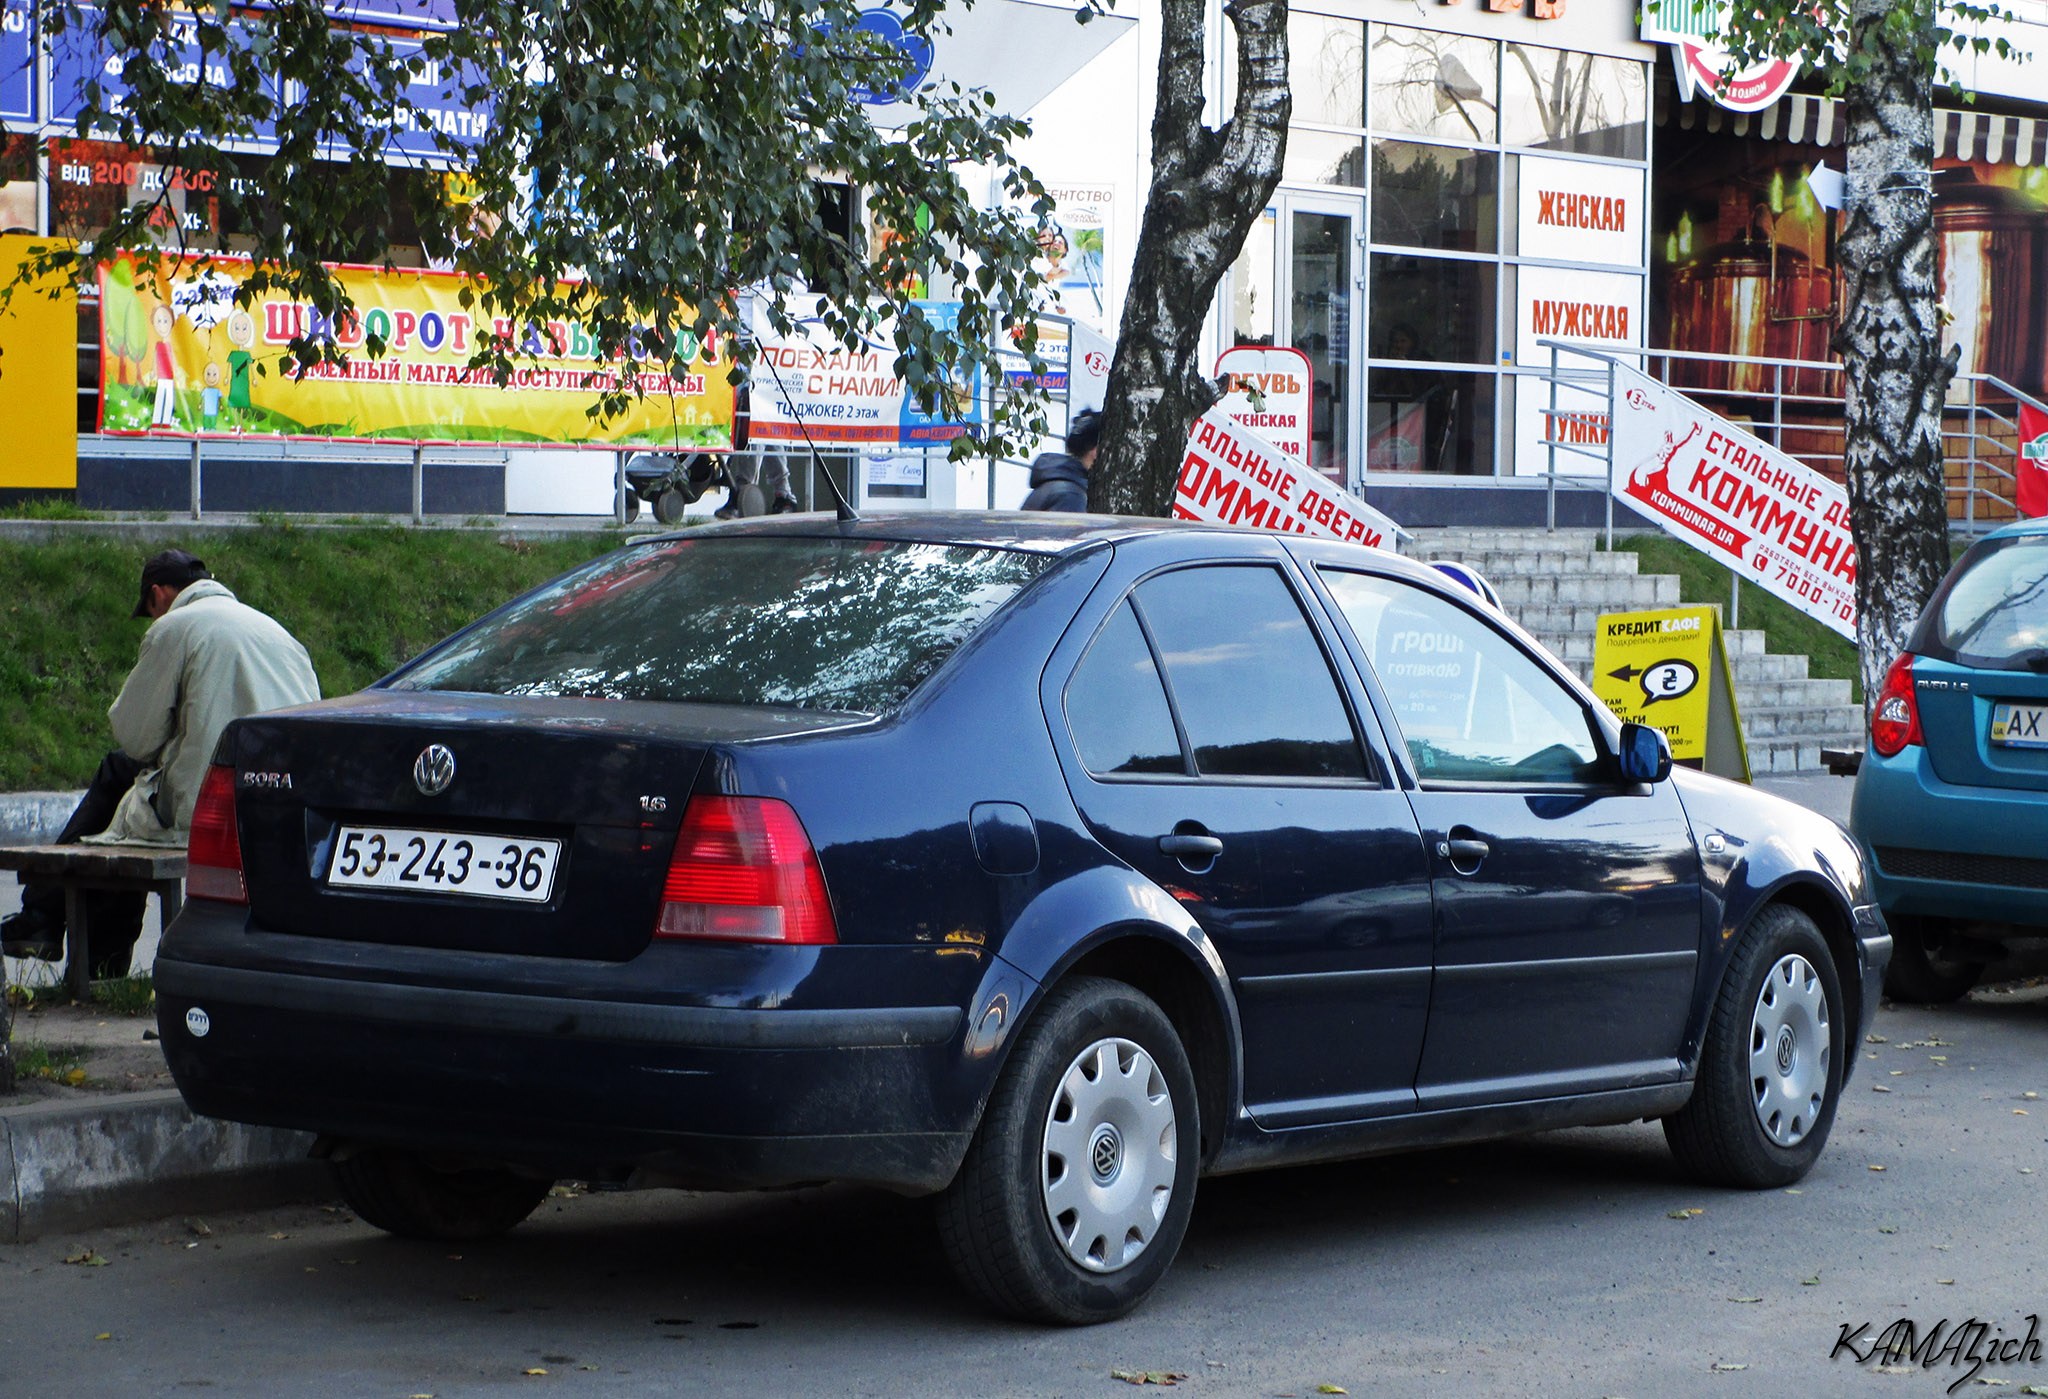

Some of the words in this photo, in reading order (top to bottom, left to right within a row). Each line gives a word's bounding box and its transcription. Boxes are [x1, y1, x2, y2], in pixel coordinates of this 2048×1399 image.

[61, 159, 91, 185] від
[94, 162, 136, 185] 200
[1537, 190, 1625, 232] ЖЕНСКАЯ
[265, 302, 470, 352] ШИВОРОТ
[1533, 300, 1628, 340] МУЖСКАЯ
[759, 347, 878, 372] ПОЕХАЛИ
[1039, 343, 1046, 353] 2
[1093, 358, 1102, 371] 3
[808, 375, 823, 394] С
[828, 376, 900, 397] НАМИ!
[776, 401, 793, 419] ТЦ
[847, 405, 853, 418] 2
[855, 407, 880, 419] этаж
[1633, 394, 1641, 405] 3
[1705, 431, 1822, 512] СТАЛЬНЫЕ
[1651, 489, 1735, 547] KOMMUNAR.UA
[1758, 543, 1801, 573] РАБОТАЕМ
[1803, 570, 1820, 584] БЕЗ
[1606, 634, 1657, 647] Подкрепись
[1658, 632, 1700, 645] деньгами!
[2007, 710, 2042, 737] AX
[243, 772, 293, 789] BORA
[339, 832, 546, 892] 53-243-36
